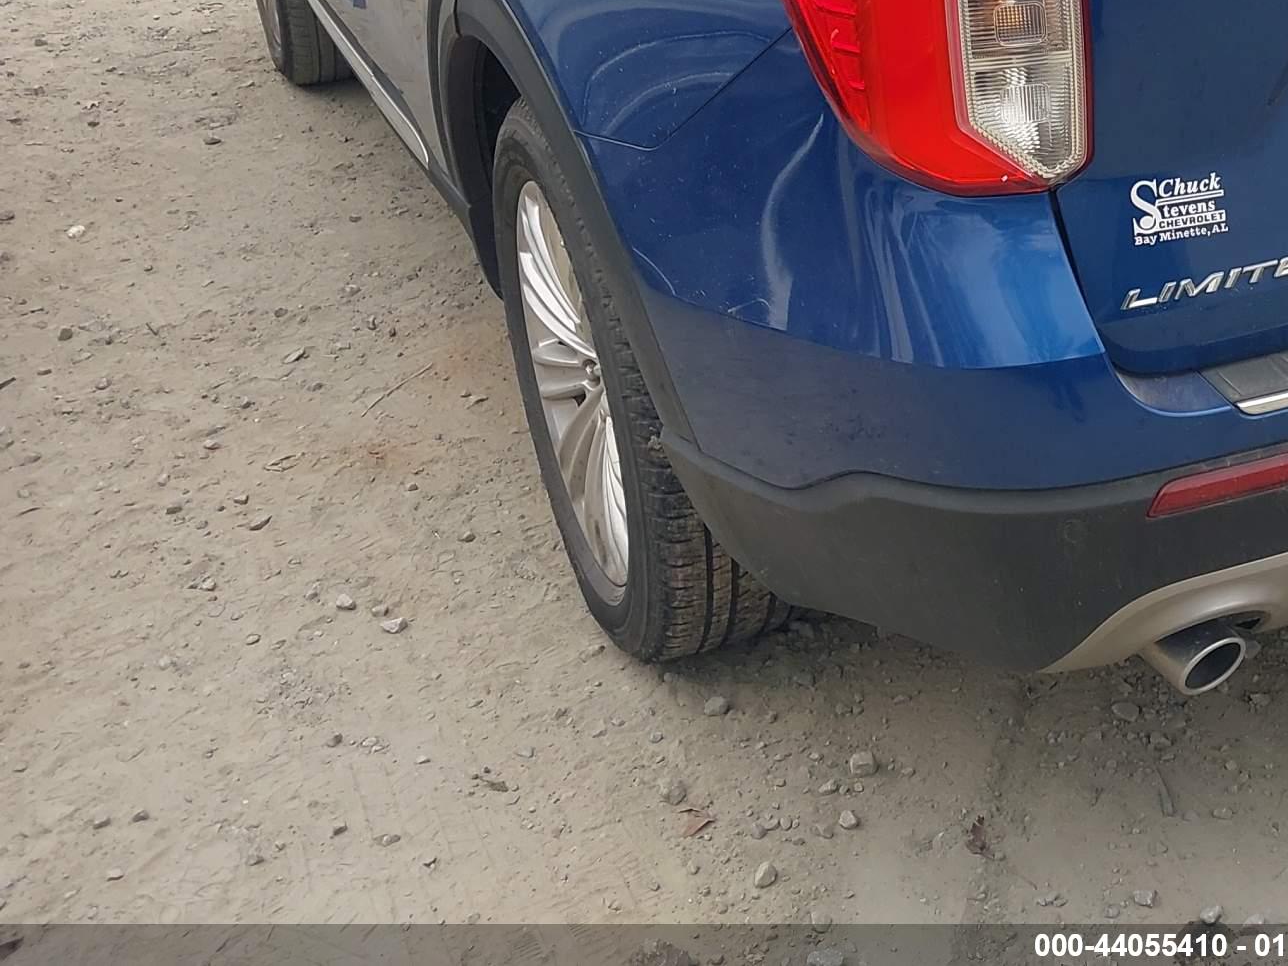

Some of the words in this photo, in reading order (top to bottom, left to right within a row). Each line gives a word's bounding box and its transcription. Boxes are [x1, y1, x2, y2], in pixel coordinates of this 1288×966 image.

[1158, 172, 1221, 198] Chuck
[1130, 179, 1216, 236] Stevens
[1159, 211, 1225, 229] CHEVROLET
[1134, 234, 1157, 246] Bay
[1159, 225, 1212, 242] Minette,
[1212, 223, 1229, 234] AL
